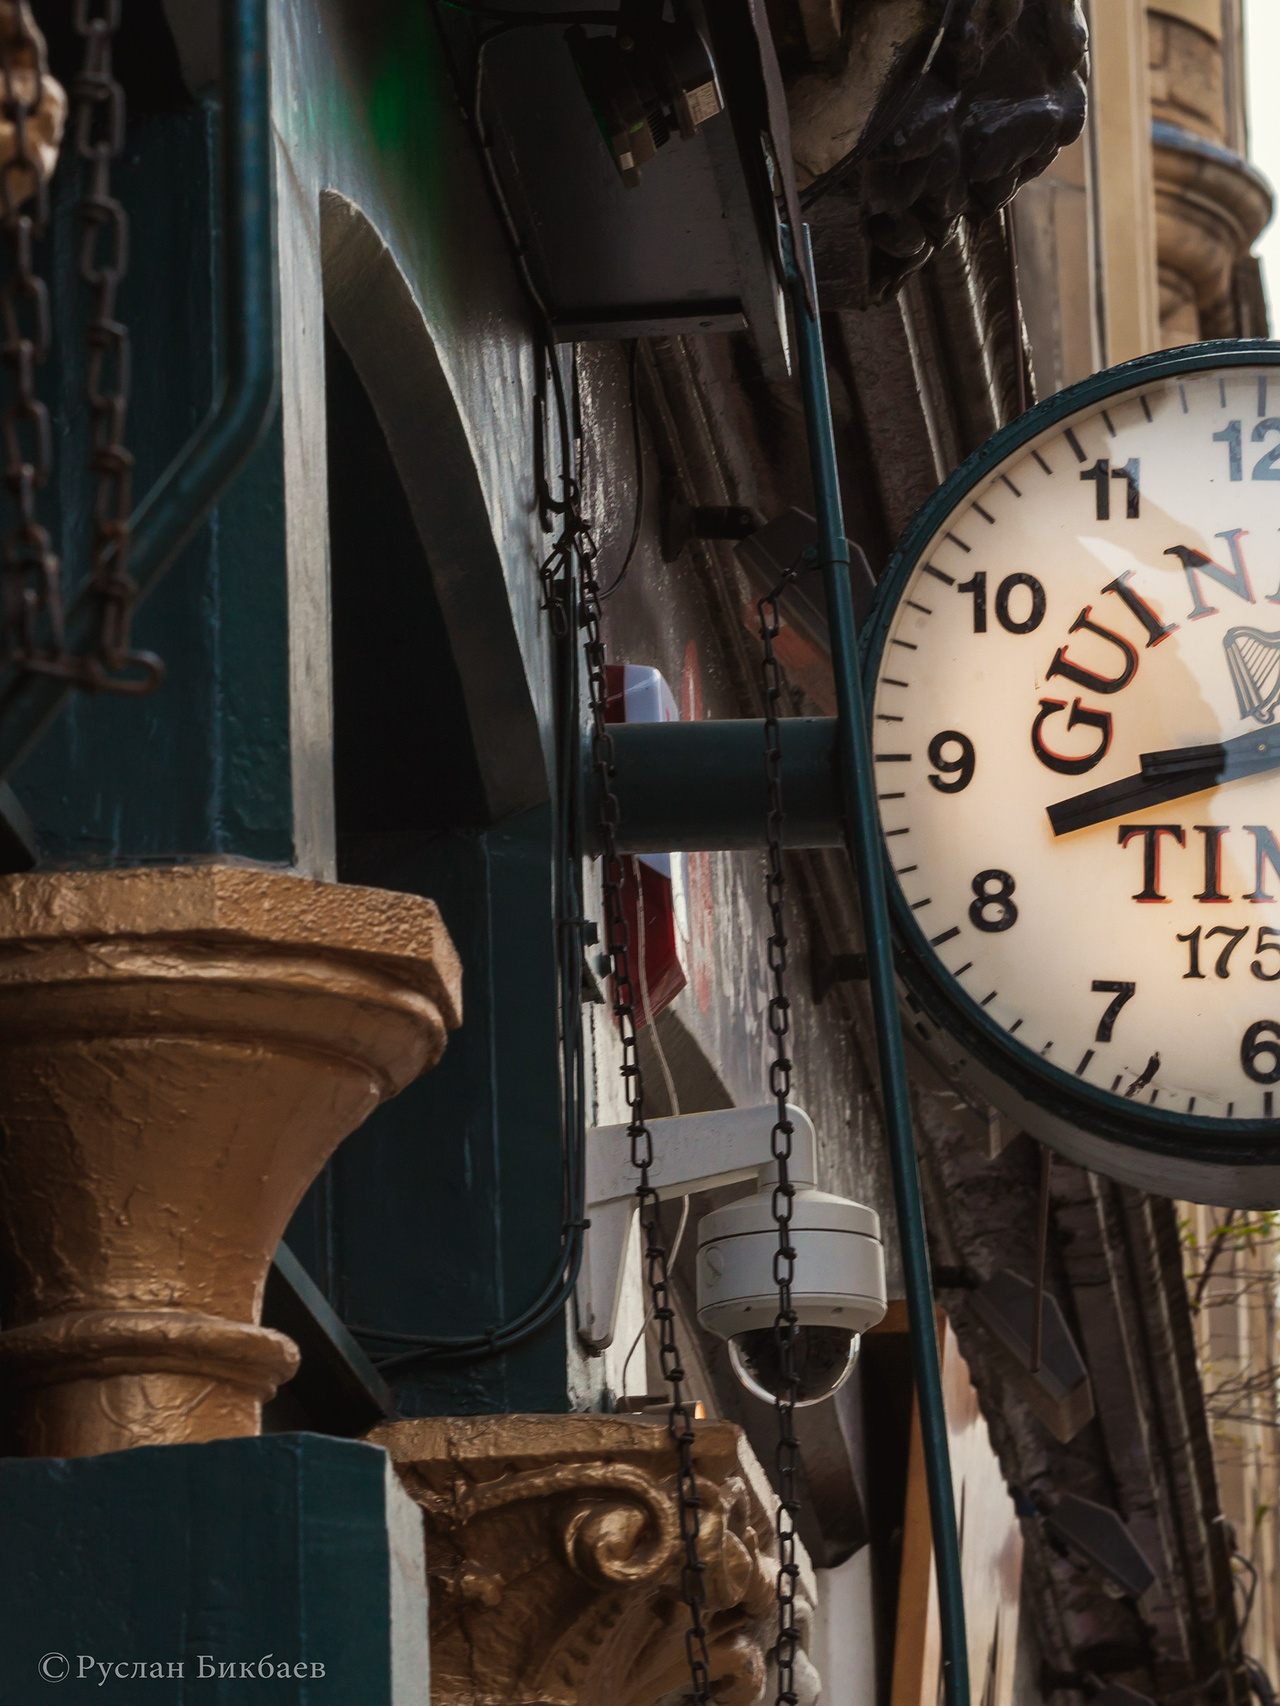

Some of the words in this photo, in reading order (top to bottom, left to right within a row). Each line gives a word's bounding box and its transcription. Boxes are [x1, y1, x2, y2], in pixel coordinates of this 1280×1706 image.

[1080, 457, 1142, 521] 11
[958, 571, 1047, 634] 10
[927, 730, 976, 794] 9
[968, 869, 1019, 933] 8
[1091, 980, 1137, 1043] 7
